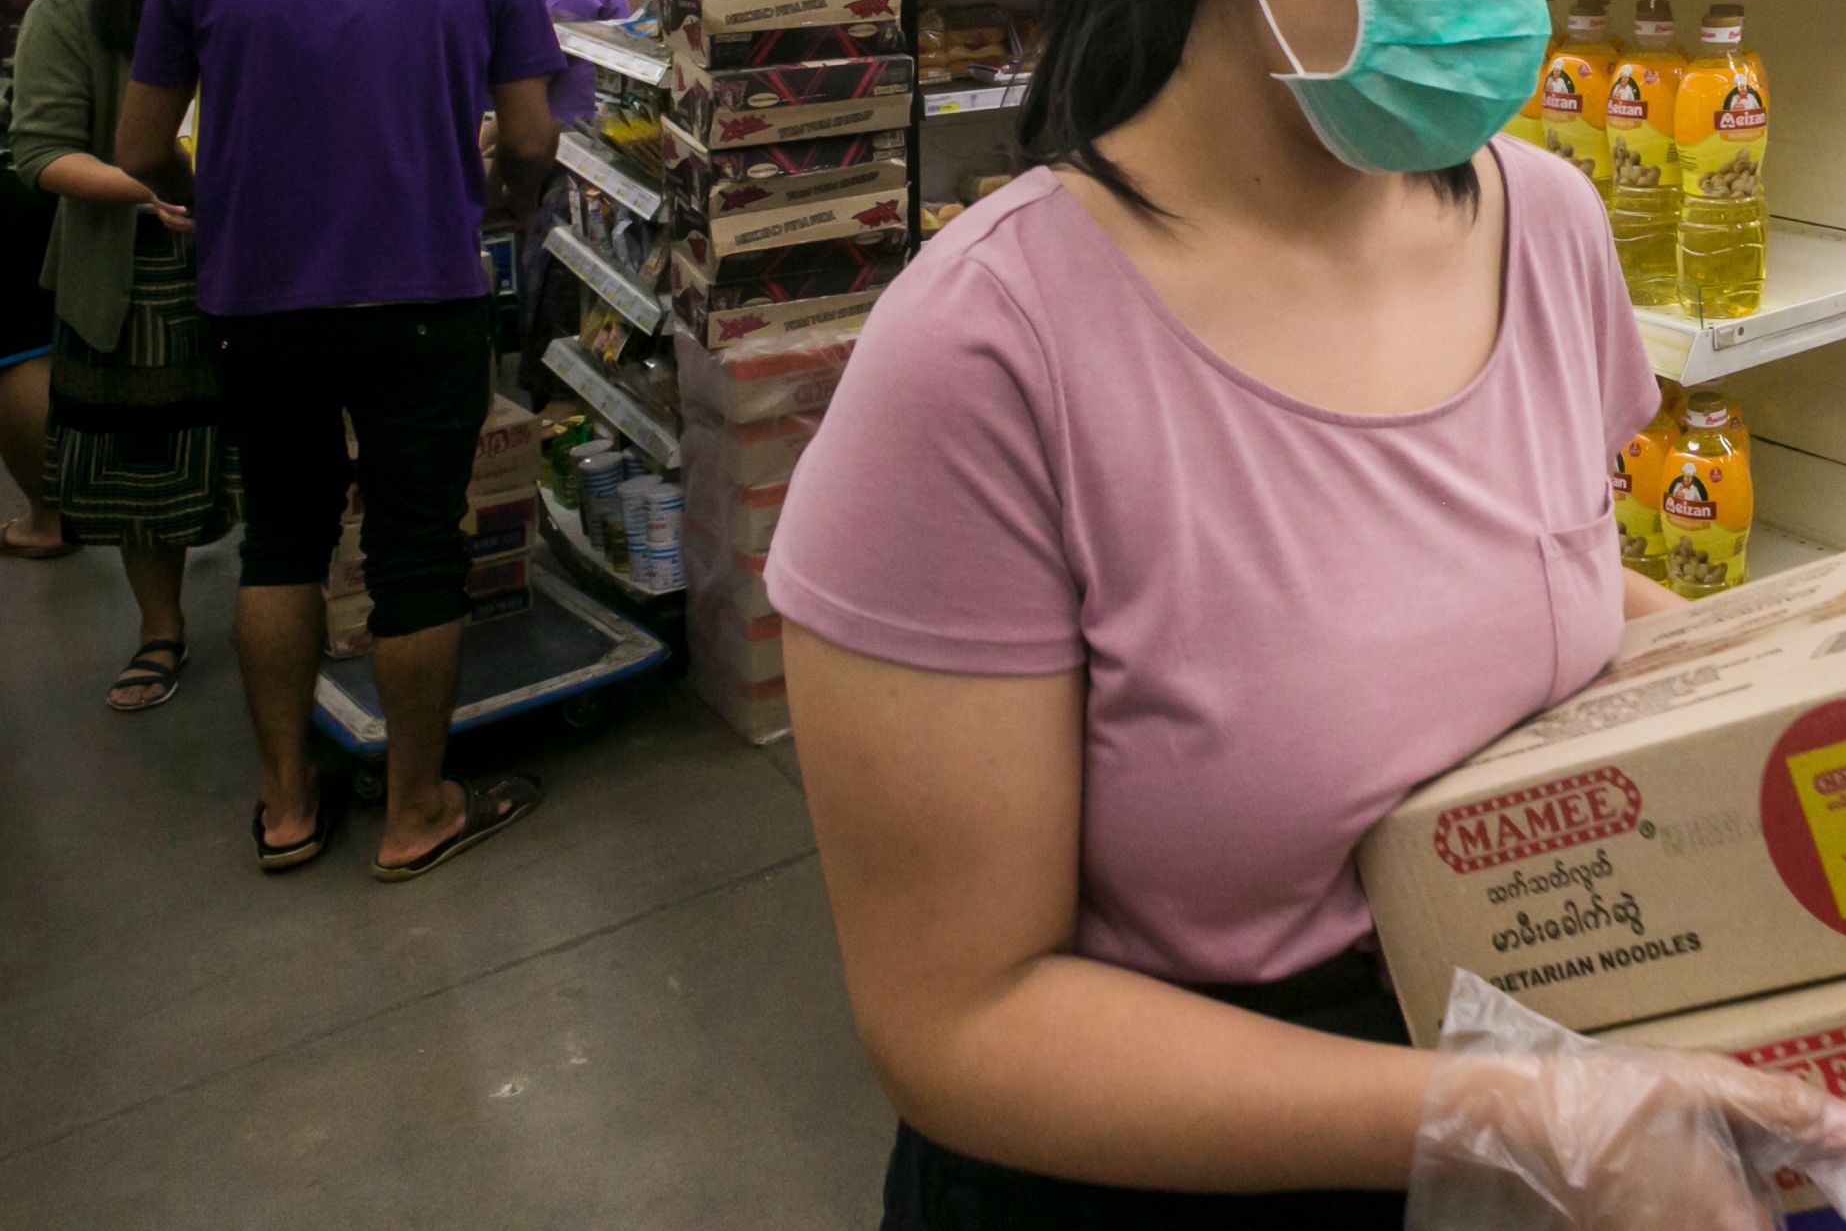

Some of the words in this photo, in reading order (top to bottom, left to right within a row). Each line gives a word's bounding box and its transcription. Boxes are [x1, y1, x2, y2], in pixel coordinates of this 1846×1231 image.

[1720, 109, 1766, 128] Meizan
[1665, 499, 1711, 517] Meizan
[1456, 787, 1618, 857] MAMEE
[1599, 932, 1702, 972] NOODLES
